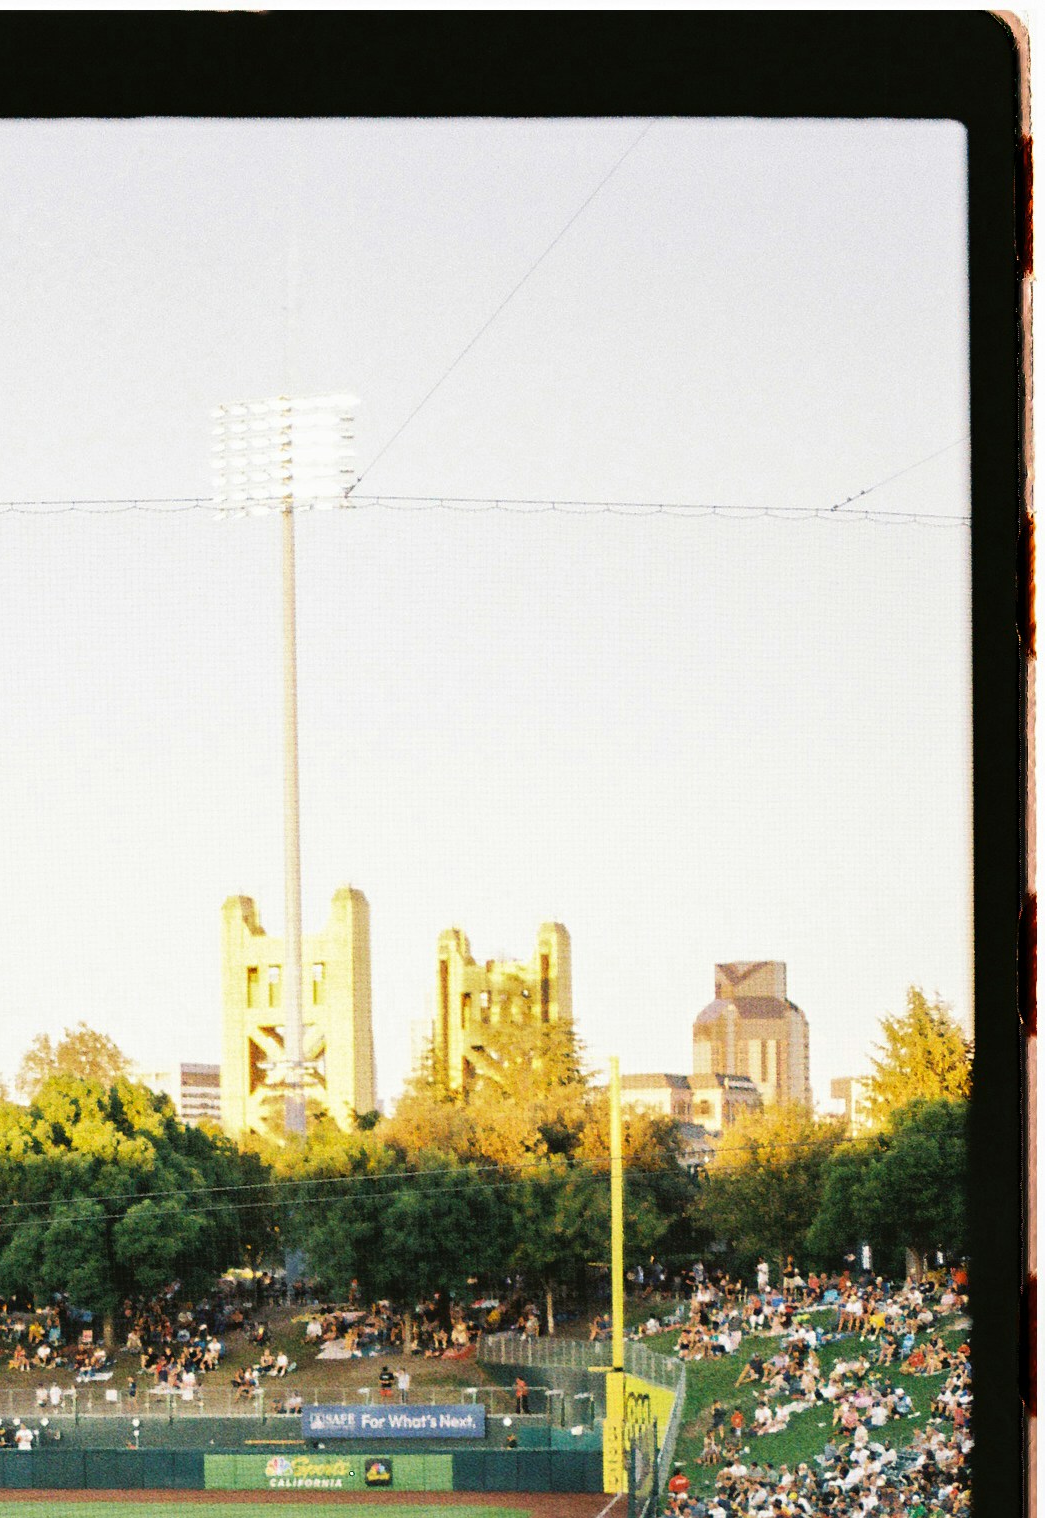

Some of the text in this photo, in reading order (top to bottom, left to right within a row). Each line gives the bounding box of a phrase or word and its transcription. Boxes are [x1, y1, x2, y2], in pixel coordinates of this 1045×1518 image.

[361, 1414, 386, 1429] For
[388, 1413, 437, 1429] What's
[439, 1414, 476, 1429] Next.
[270, 1478, 343, 1488] CALIFORNIA
